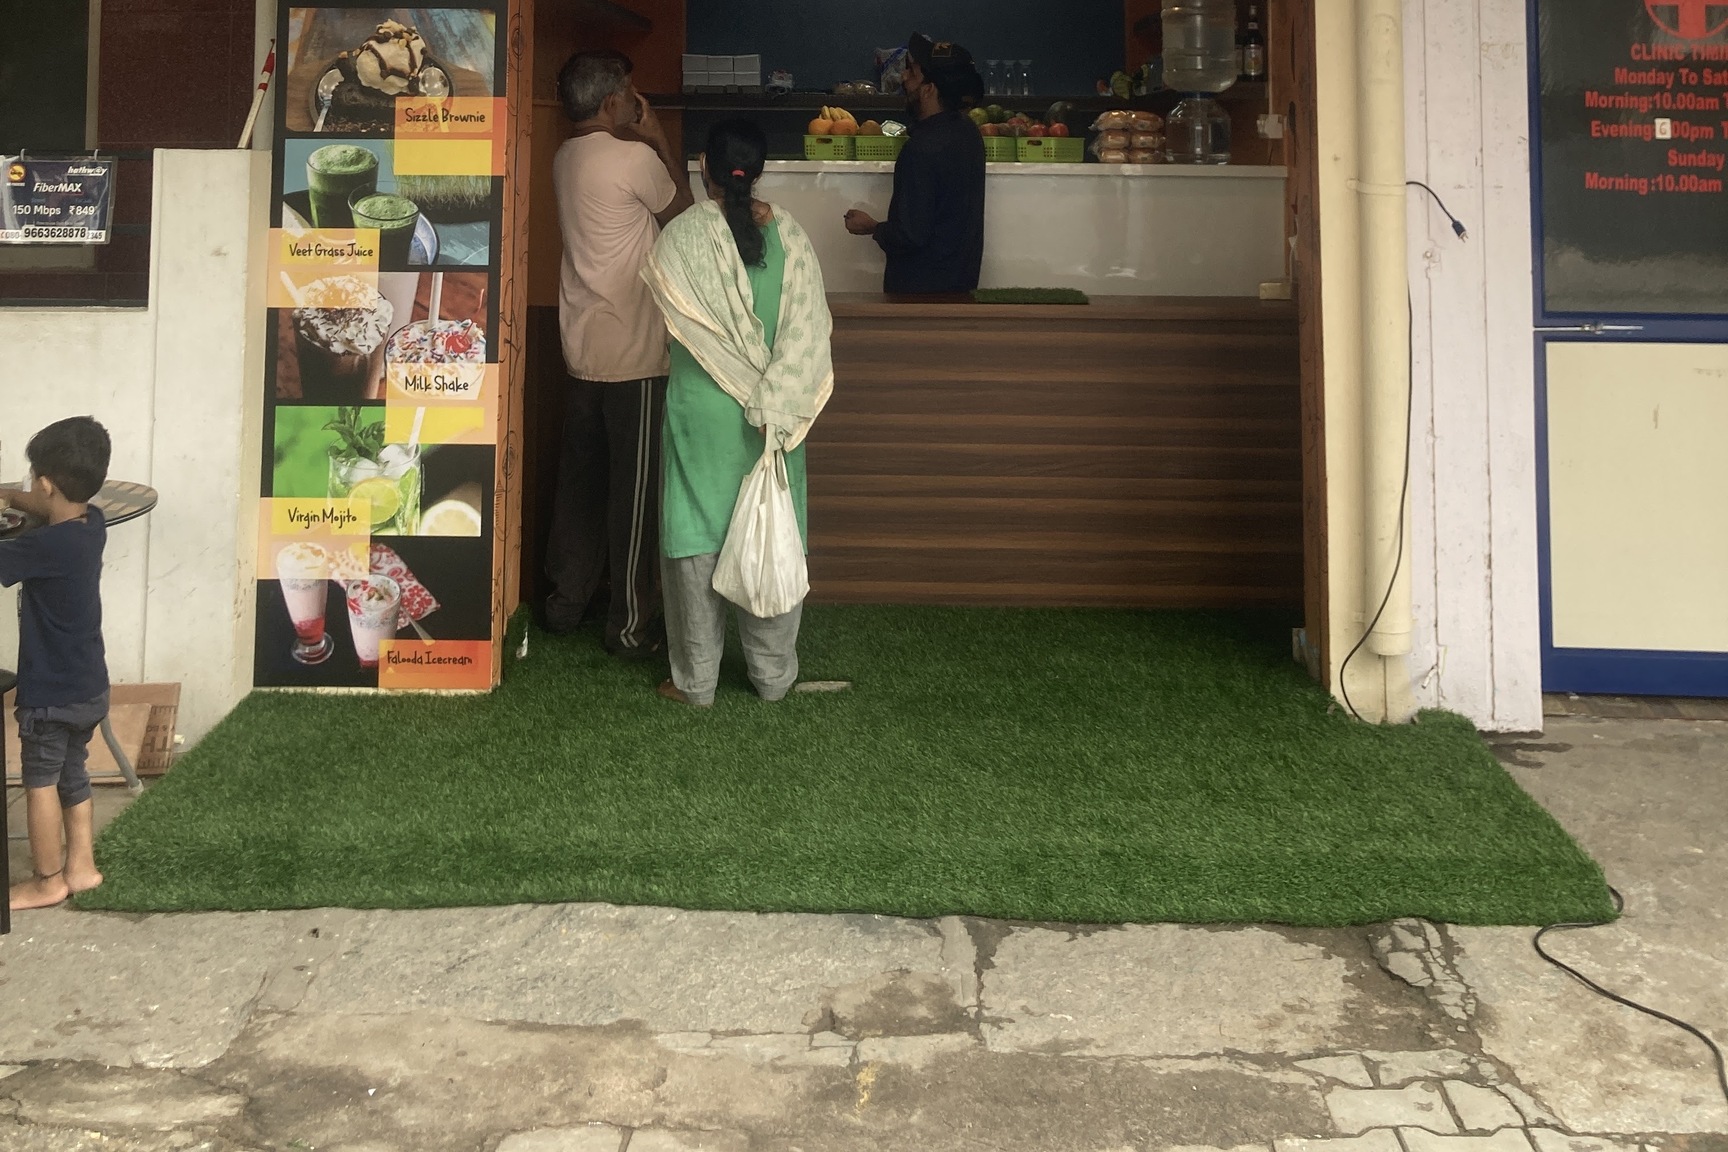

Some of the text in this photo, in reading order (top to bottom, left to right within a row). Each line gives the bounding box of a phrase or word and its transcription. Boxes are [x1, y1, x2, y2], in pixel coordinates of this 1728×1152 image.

[1630, 43, 1685, 61] CLINIC
[1614, 67, 1675, 89] Monday
[1679, 68, 1698, 85] To
[405, 107, 486, 123] Sizzle Brownie
[1667, 149, 1725, 171] Sunday
[33, 182, 82, 193] FiberMAX
[12, 205, 31, 215] 150
[33, 205, 62, 217] Mbps
[24, 228, 86, 238] 9663628878
[289, 243, 374, 257] Veet Grass Juice
[404, 375, 469, 392] Milk Shake
[288, 507, 357, 529] Virgin Mojito
[387, 650, 473, 665] Falooda Icecream
